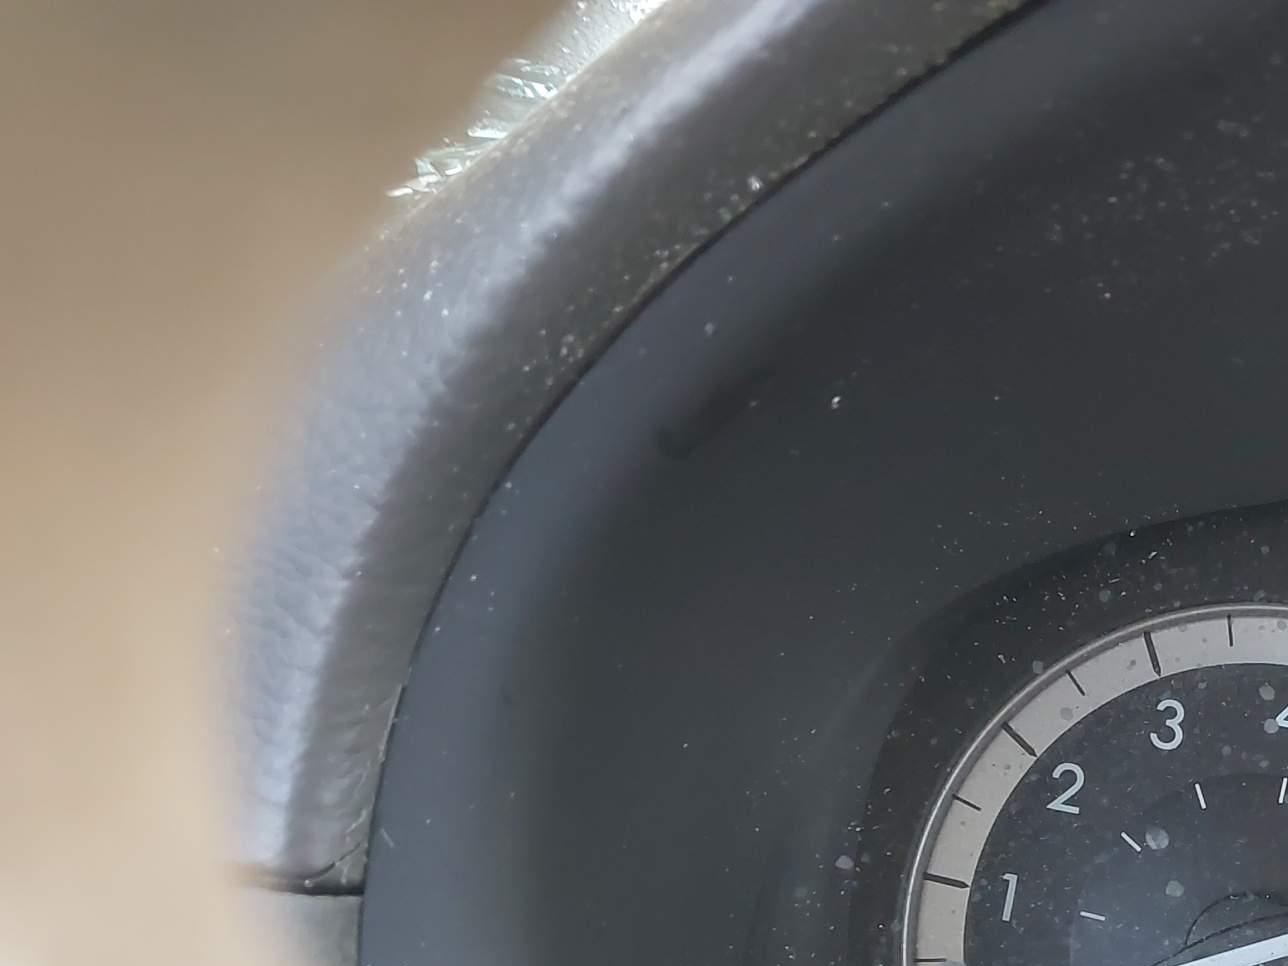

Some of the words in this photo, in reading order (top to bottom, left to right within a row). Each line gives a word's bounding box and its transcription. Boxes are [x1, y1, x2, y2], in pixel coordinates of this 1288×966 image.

[1150, 699, 1185, 750] 3
[1046, 762, 1086, 814] 2
[999, 873, 1019, 922] 1
